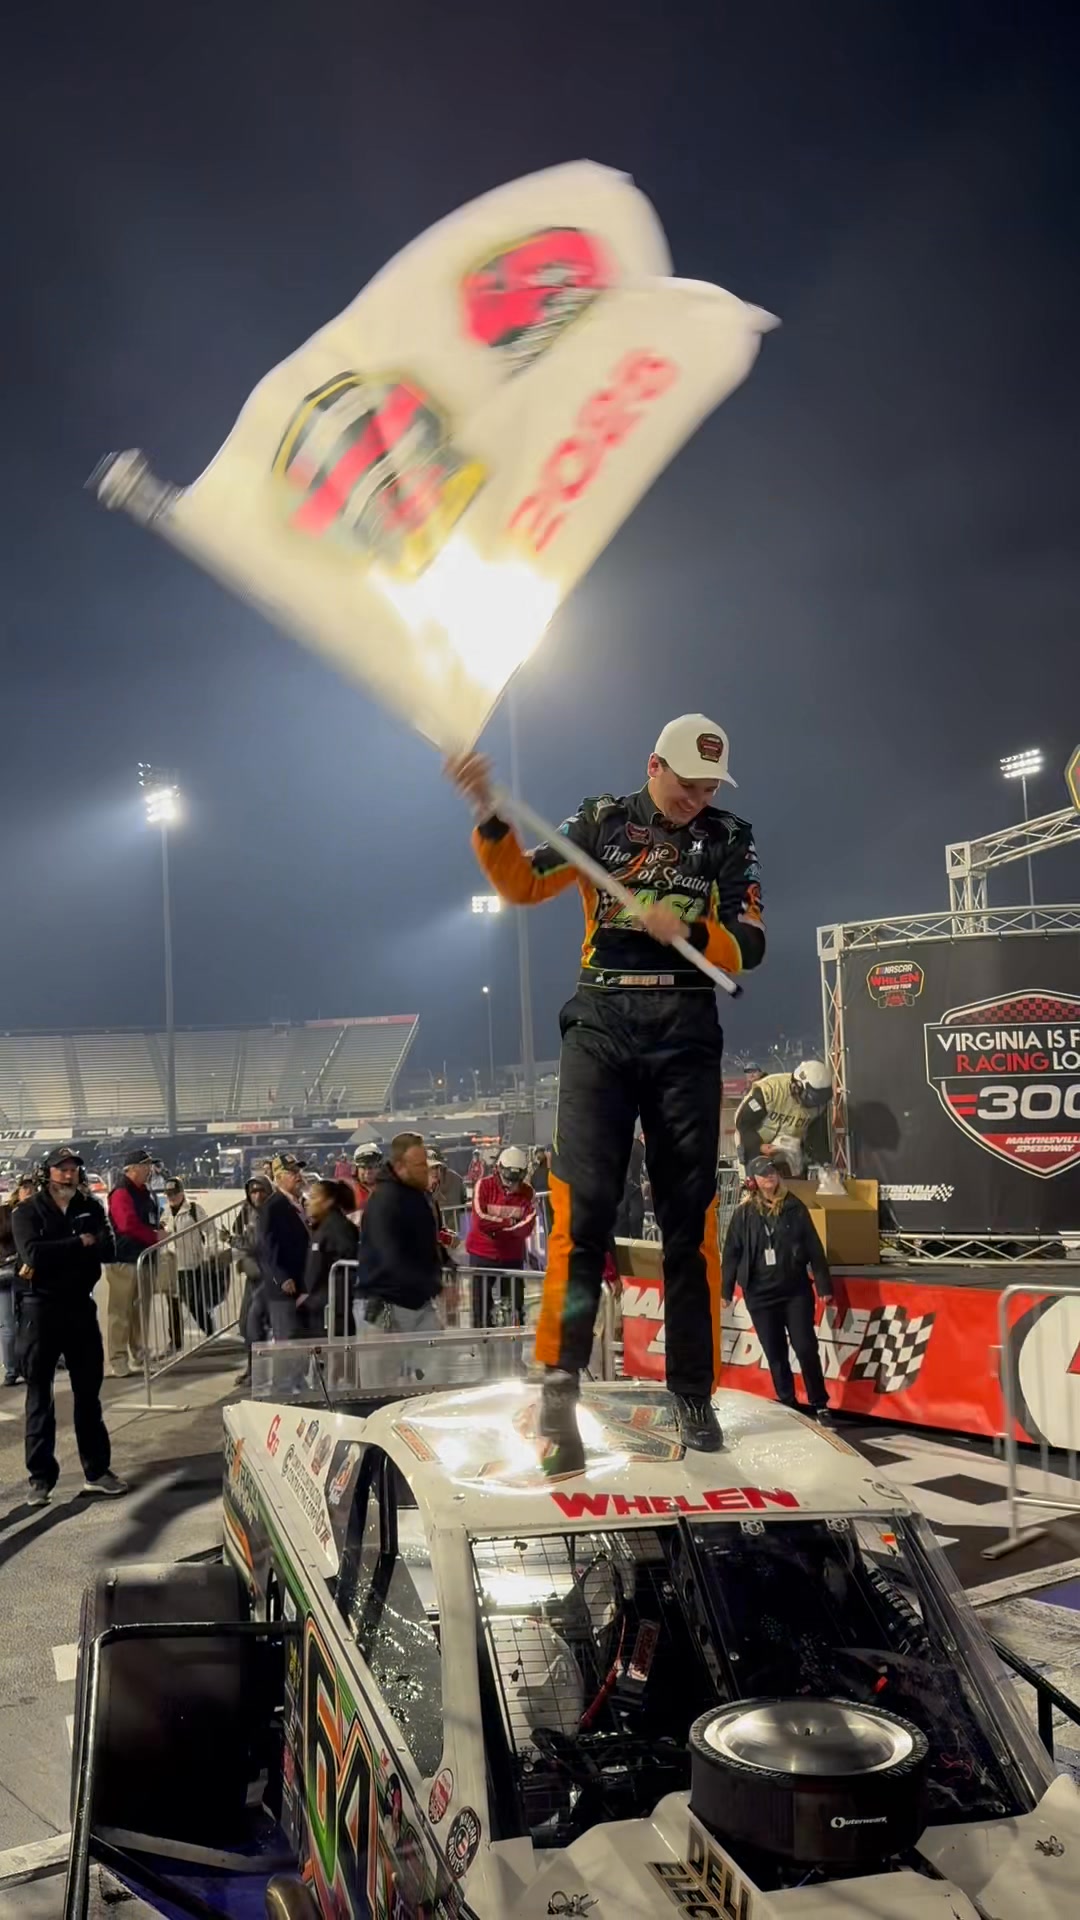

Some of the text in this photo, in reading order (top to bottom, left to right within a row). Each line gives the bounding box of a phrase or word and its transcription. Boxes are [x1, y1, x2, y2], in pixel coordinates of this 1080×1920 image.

[601, 845, 632, 862] The
[638, 866, 660, 882] of
[883, 964, 913, 974] NASCAR
[870, 972, 920, 987] WHELEN
[937, 1031, 1042, 1051] VIRGINIA
[1047, 1029, 1066, 1049] IS
[956, 1051, 1049, 1073] RACING
[1005, 1136, 1080, 1145] MARTINSVILL
[1014, 1144, 1075, 1153] SPEEDWAY
[550, 1487, 800, 1518] WHELEN
